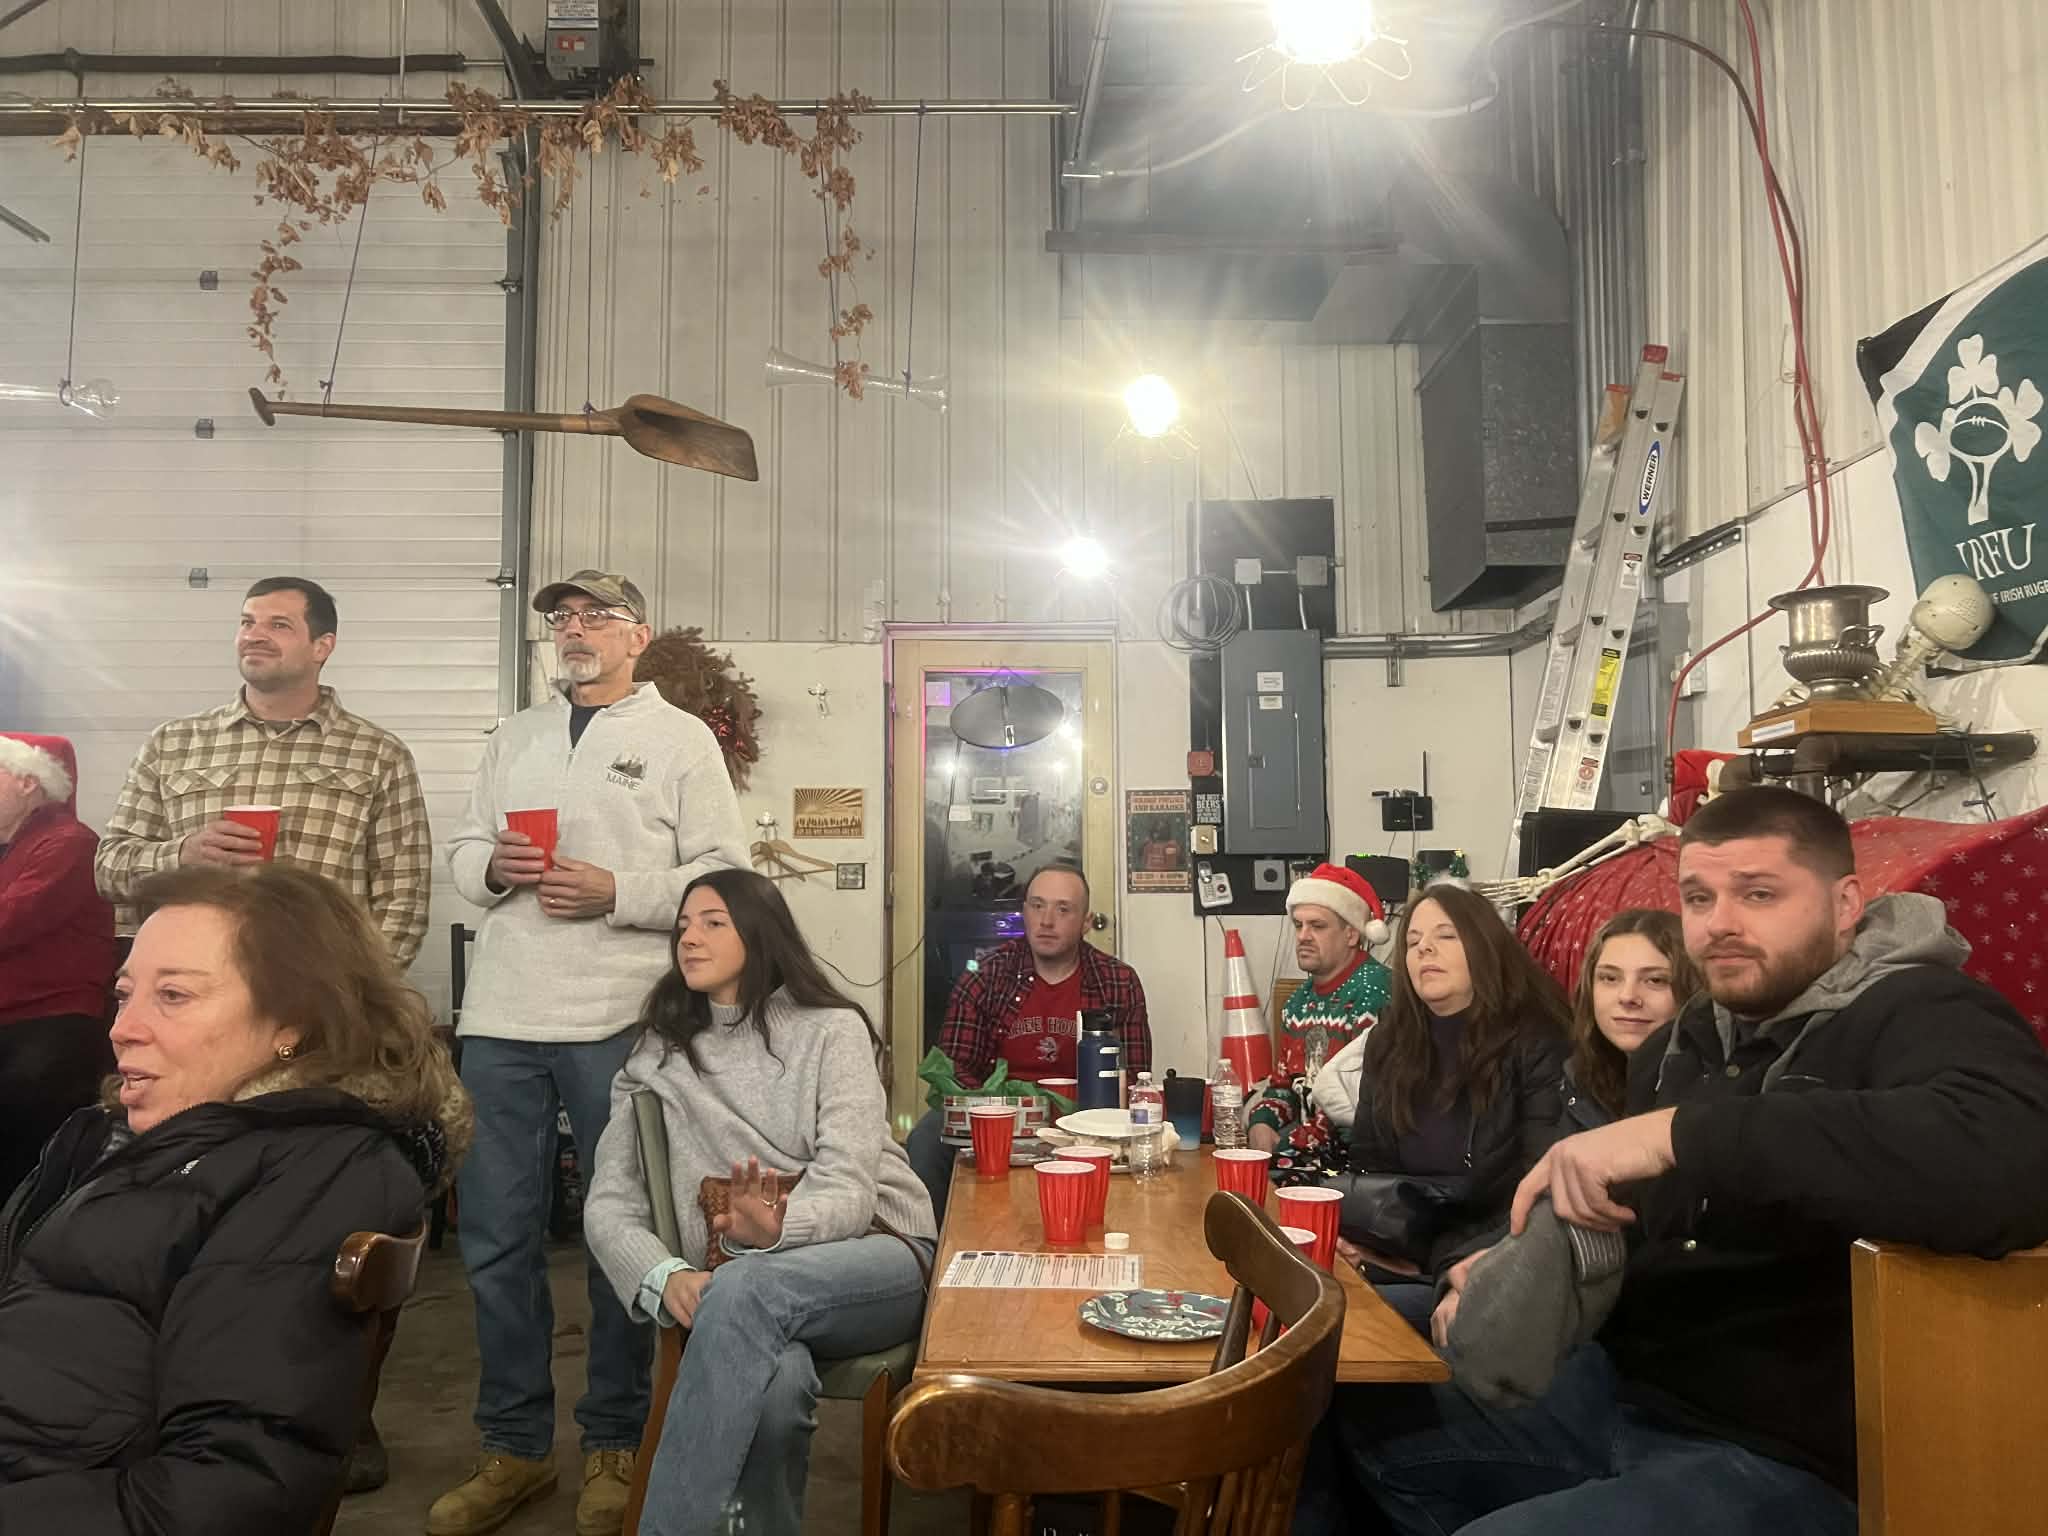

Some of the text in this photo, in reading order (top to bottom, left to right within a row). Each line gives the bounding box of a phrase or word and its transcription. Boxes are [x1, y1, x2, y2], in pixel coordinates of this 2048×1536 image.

[1642, 454, 1657, 500] WERNER
[1955, 523, 2037, 581] IRFU
[2000, 586, 2025, 603] IRISH
[606, 773, 641, 792] MAINE
[1196, 800, 1221, 809] BEERS
